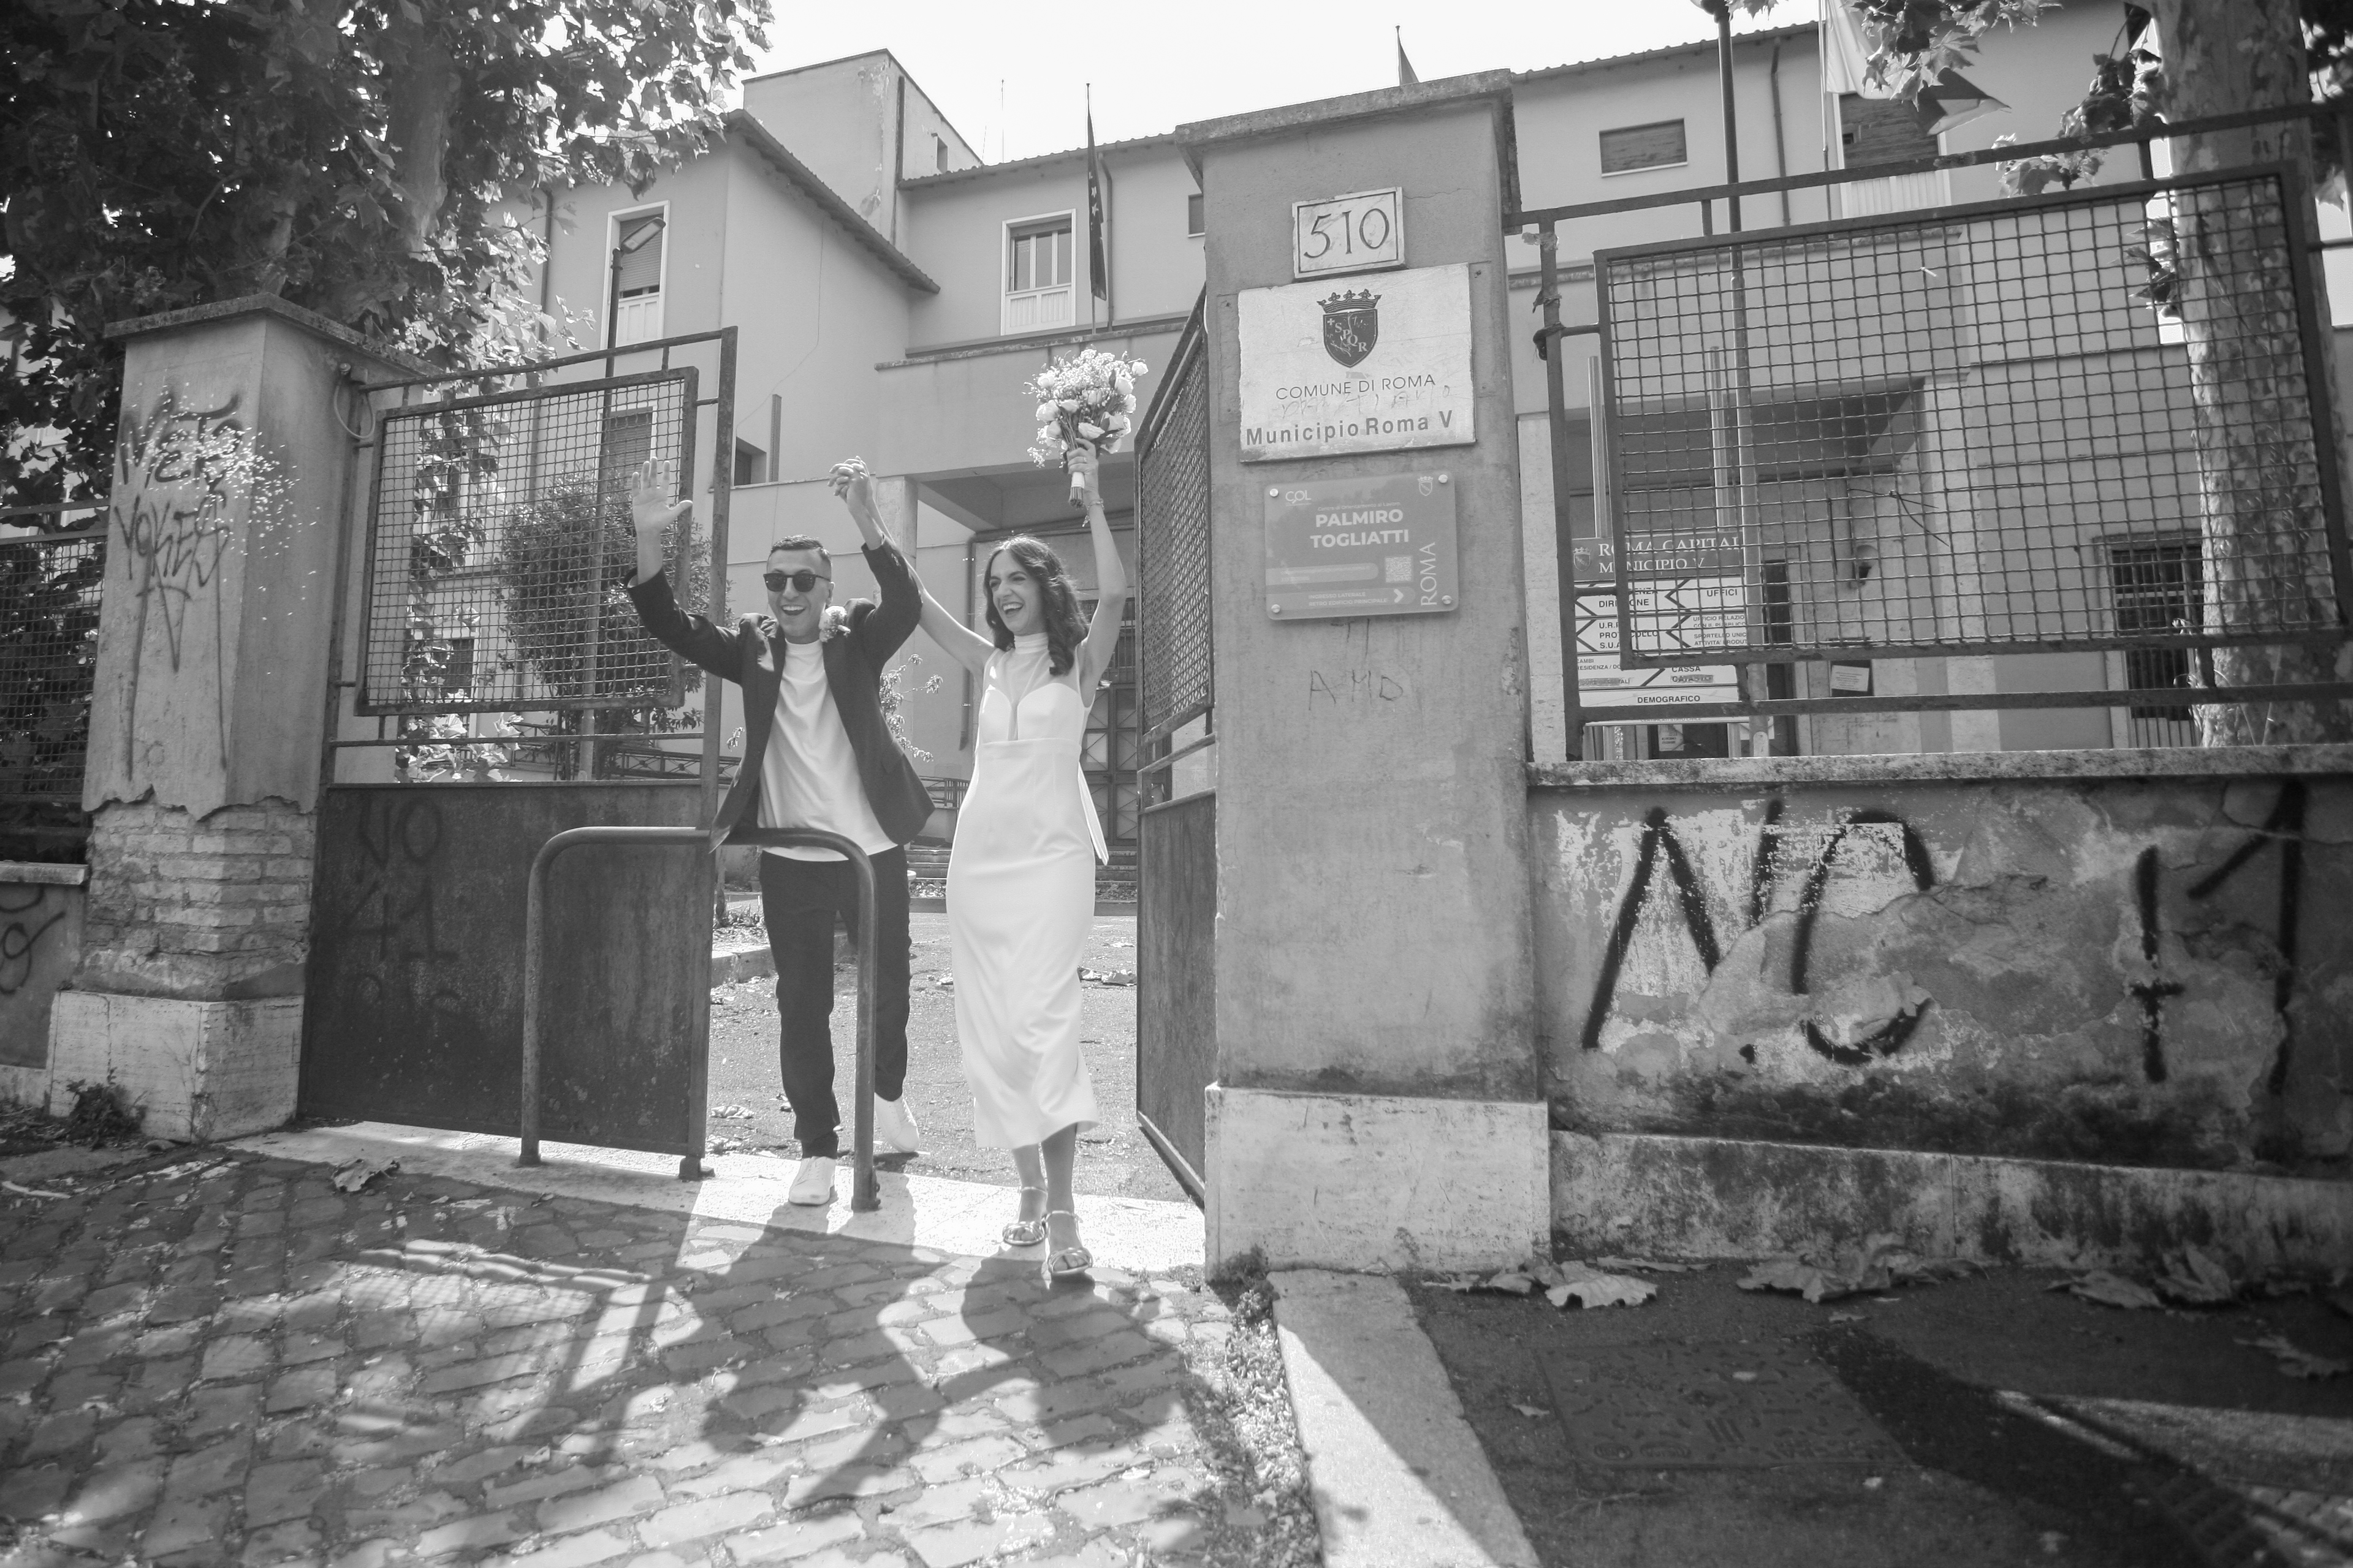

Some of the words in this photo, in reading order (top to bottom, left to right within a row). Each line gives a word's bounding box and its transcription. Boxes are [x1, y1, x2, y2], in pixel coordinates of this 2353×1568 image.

[1303, 208, 1389, 258] 510
[1334, 322, 1369, 352] SPQR
[1275, 381, 1351, 400] COMUNE
[1358, 380, 1375, 393] DI
[1382, 374, 1436, 390] ROMA
[1246, 420, 1359, 445] Municipio
[1366, 416, 1429, 436] Roma
[1439, 410, 1453, 428] V
[1285, 490, 1312, 504] COL
[1315, 509, 1404, 528] PALMIRO
[1309, 529, 1409, 548] TOGLIATTI
[1598, 541, 1657, 556] RMA
[1420, 542, 1437, 606] ROMA
[1599, 557, 1687, 573] MNICIPIO
[1693, 557, 1705, 569] V
[1706, 588, 1738, 597] UFFICI
[1598, 598, 1650, 608] DIRONE
